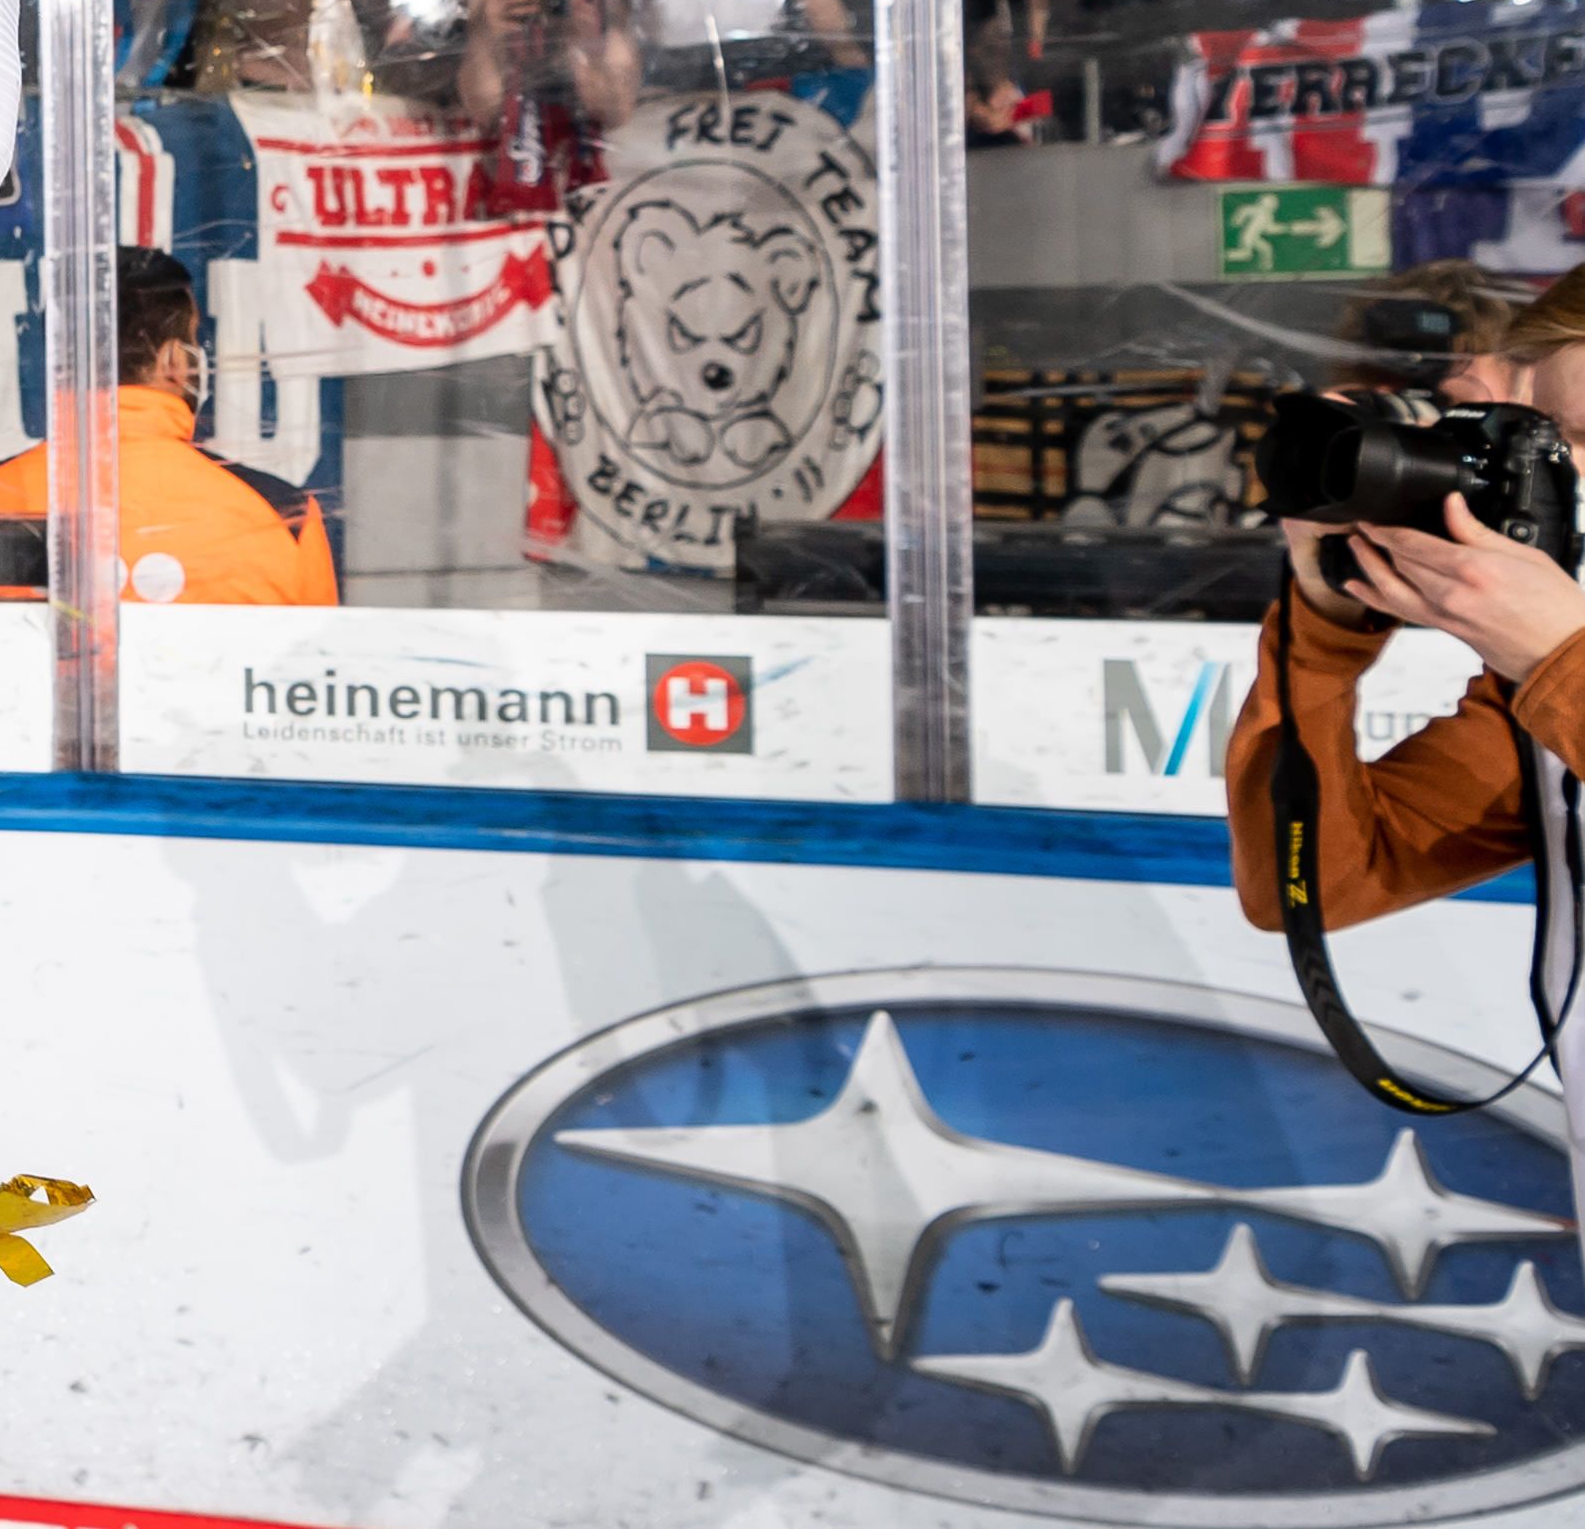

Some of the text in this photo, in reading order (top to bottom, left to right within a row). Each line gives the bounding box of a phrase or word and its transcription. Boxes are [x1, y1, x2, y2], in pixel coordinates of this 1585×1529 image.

[803, 150, 883, 324] TEAM
[243, 667, 622, 727] heinemann
[243, 721, 623, 752] Leidenschaft ist unser Strom
